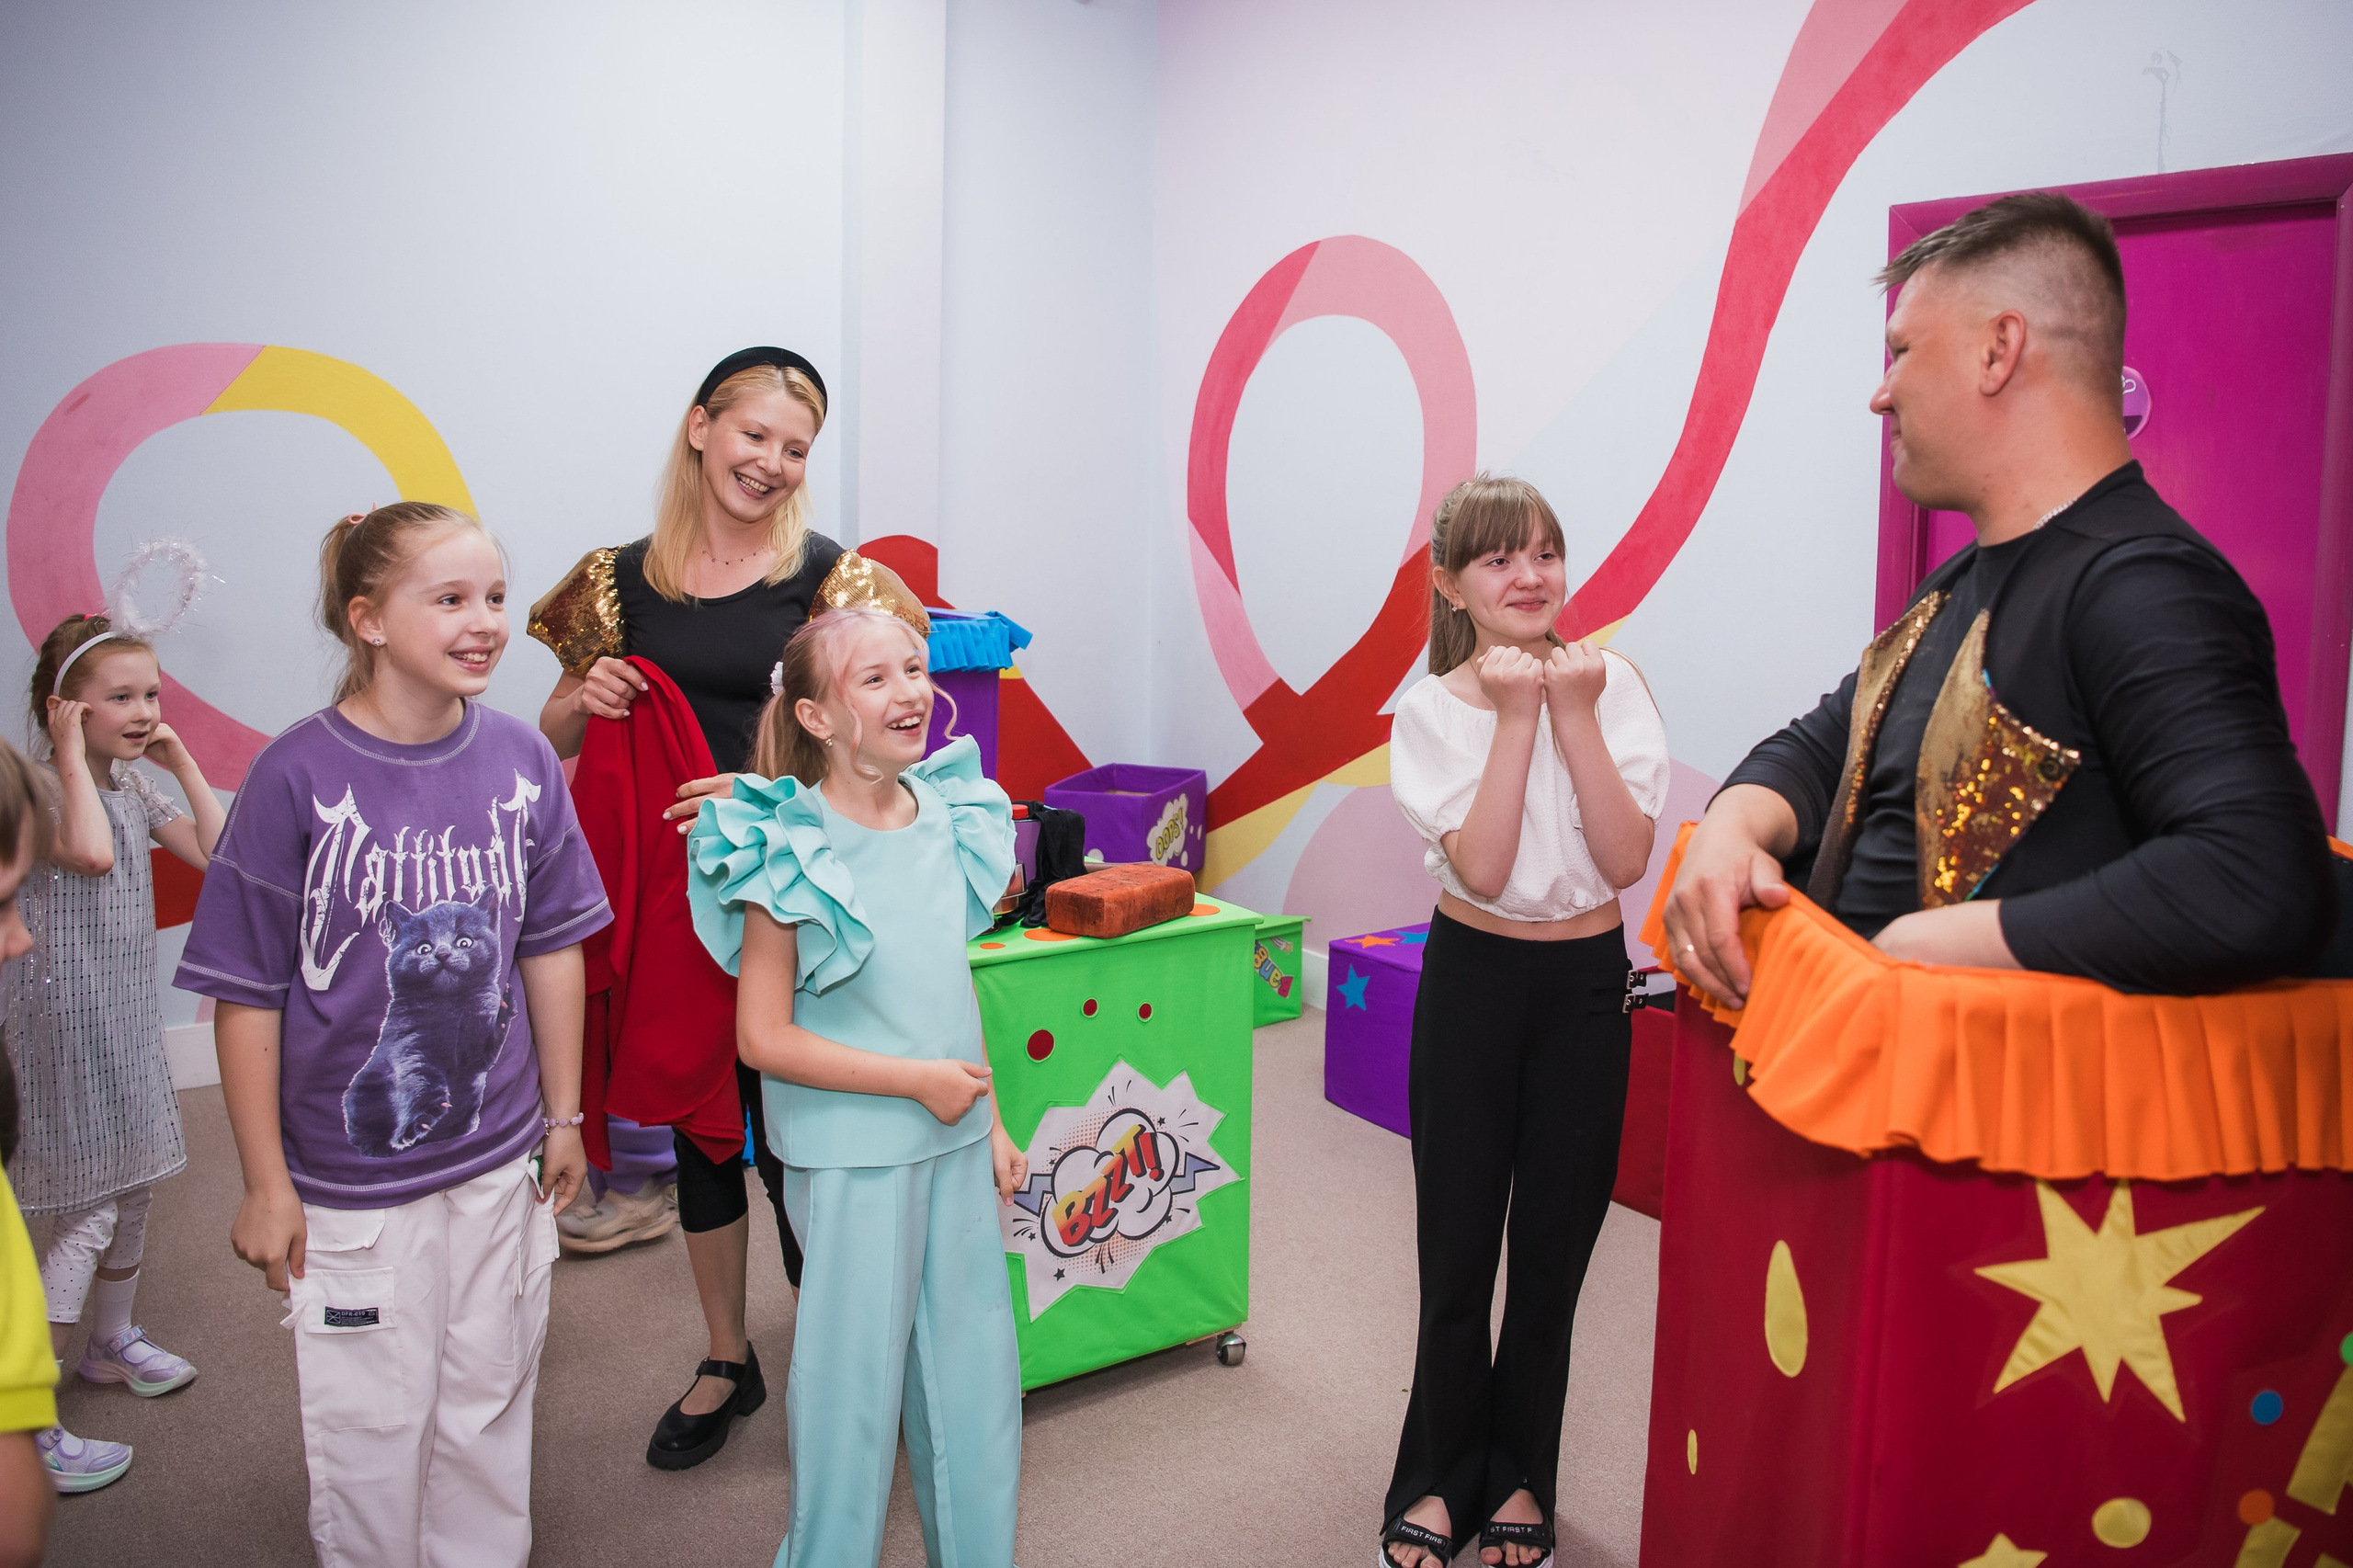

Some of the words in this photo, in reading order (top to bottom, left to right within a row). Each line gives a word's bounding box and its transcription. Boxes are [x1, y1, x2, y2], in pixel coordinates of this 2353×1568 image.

[1155, 806, 1184, 861] OOPS!
[1401, 1526, 1424, 1538] FIRST
[1425, 1533, 1446, 1547] FIRS
